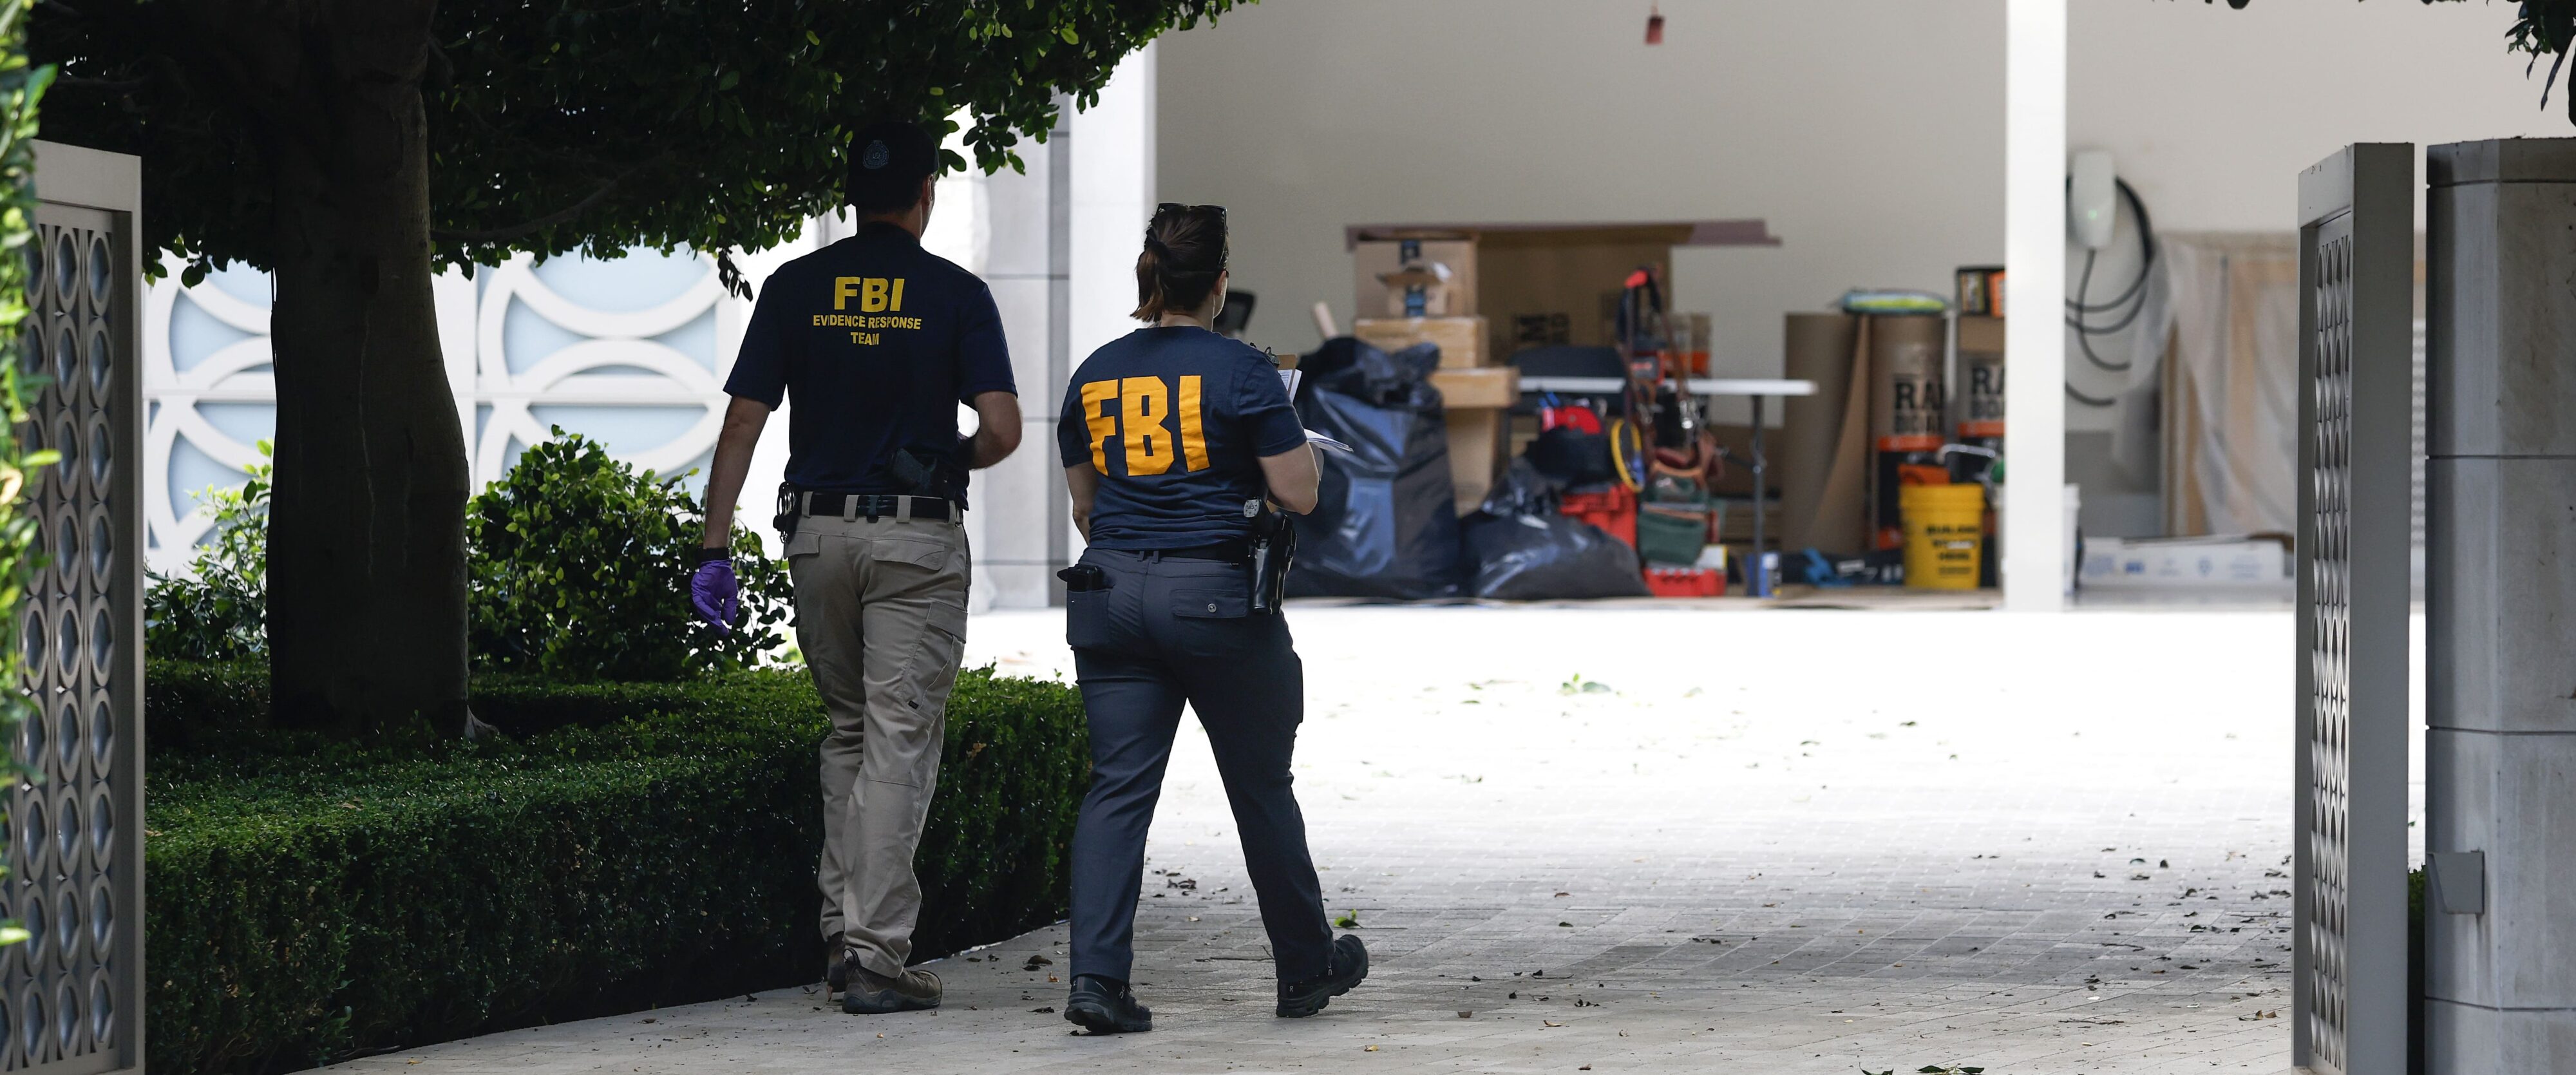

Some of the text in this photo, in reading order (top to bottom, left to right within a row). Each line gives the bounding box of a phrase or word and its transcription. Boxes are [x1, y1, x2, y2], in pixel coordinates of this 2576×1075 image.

[834, 276, 905, 312] FBI
[813, 314, 922, 330] EVIDENCE RESPONSE
[850, 332, 880, 345] TEAM
[1080, 375, 1210, 477] FBI
